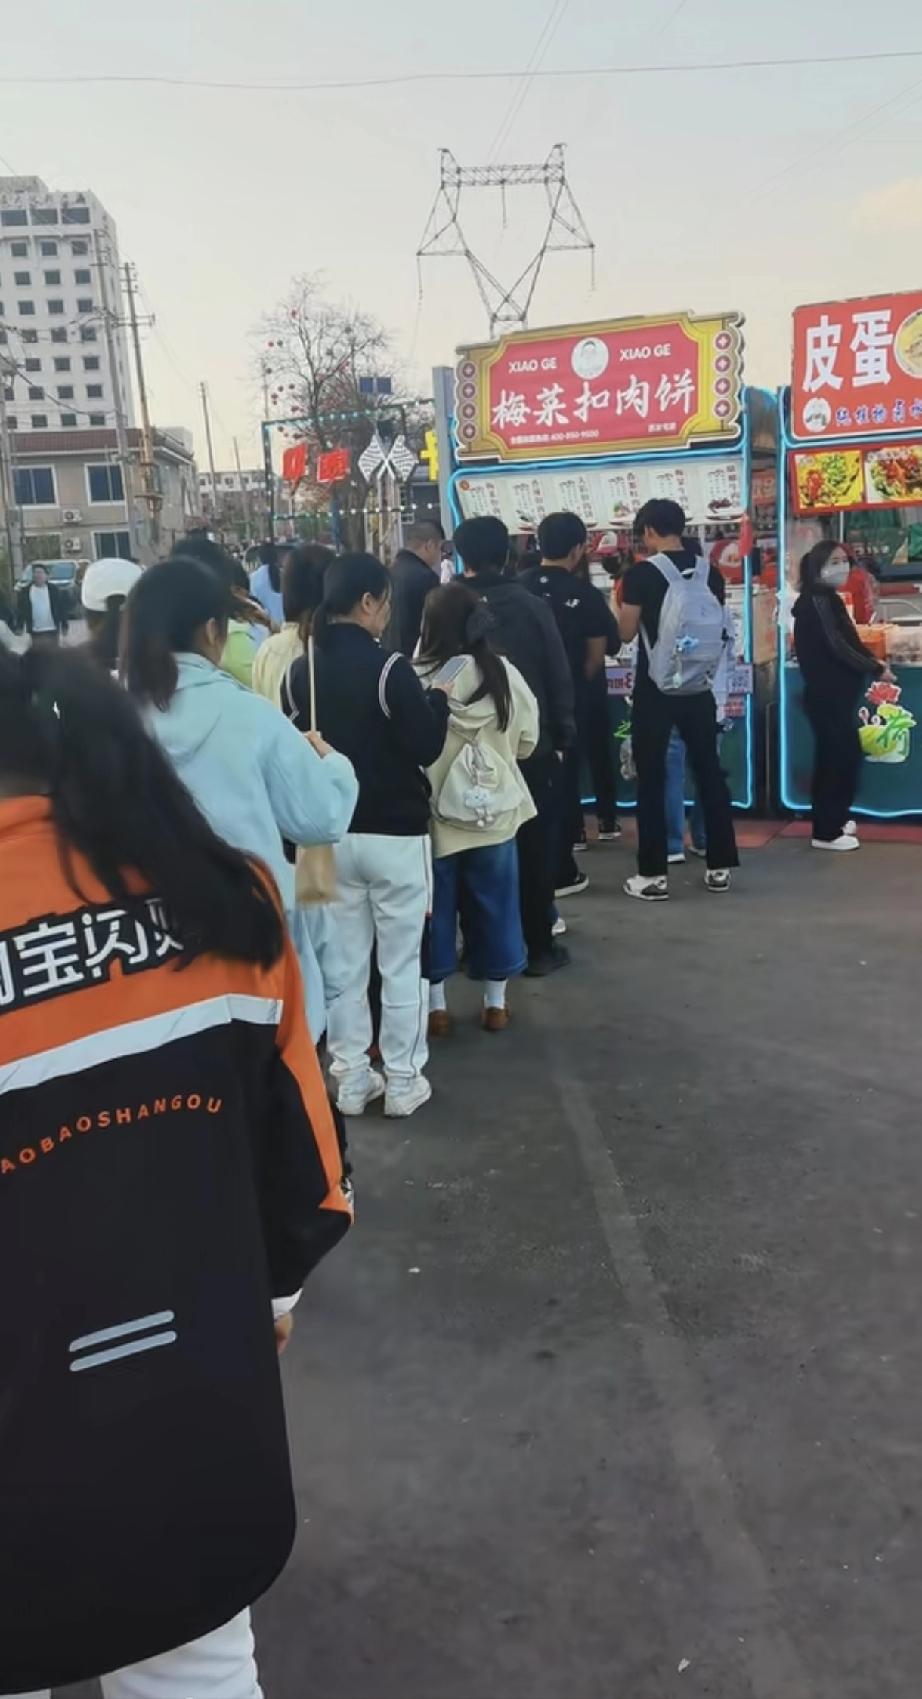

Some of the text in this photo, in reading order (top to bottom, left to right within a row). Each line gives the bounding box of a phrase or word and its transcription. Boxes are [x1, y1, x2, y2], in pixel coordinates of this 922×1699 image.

[508, 357, 558, 373] XIAO GE
[619, 344, 671, 361] XIAO GE
[802, 309, 894, 392] 皮蛋
[491, 368, 696, 429] 梅菜扣肉饼
[0, 1094, 223, 1174] AOBAOSHANGOU
